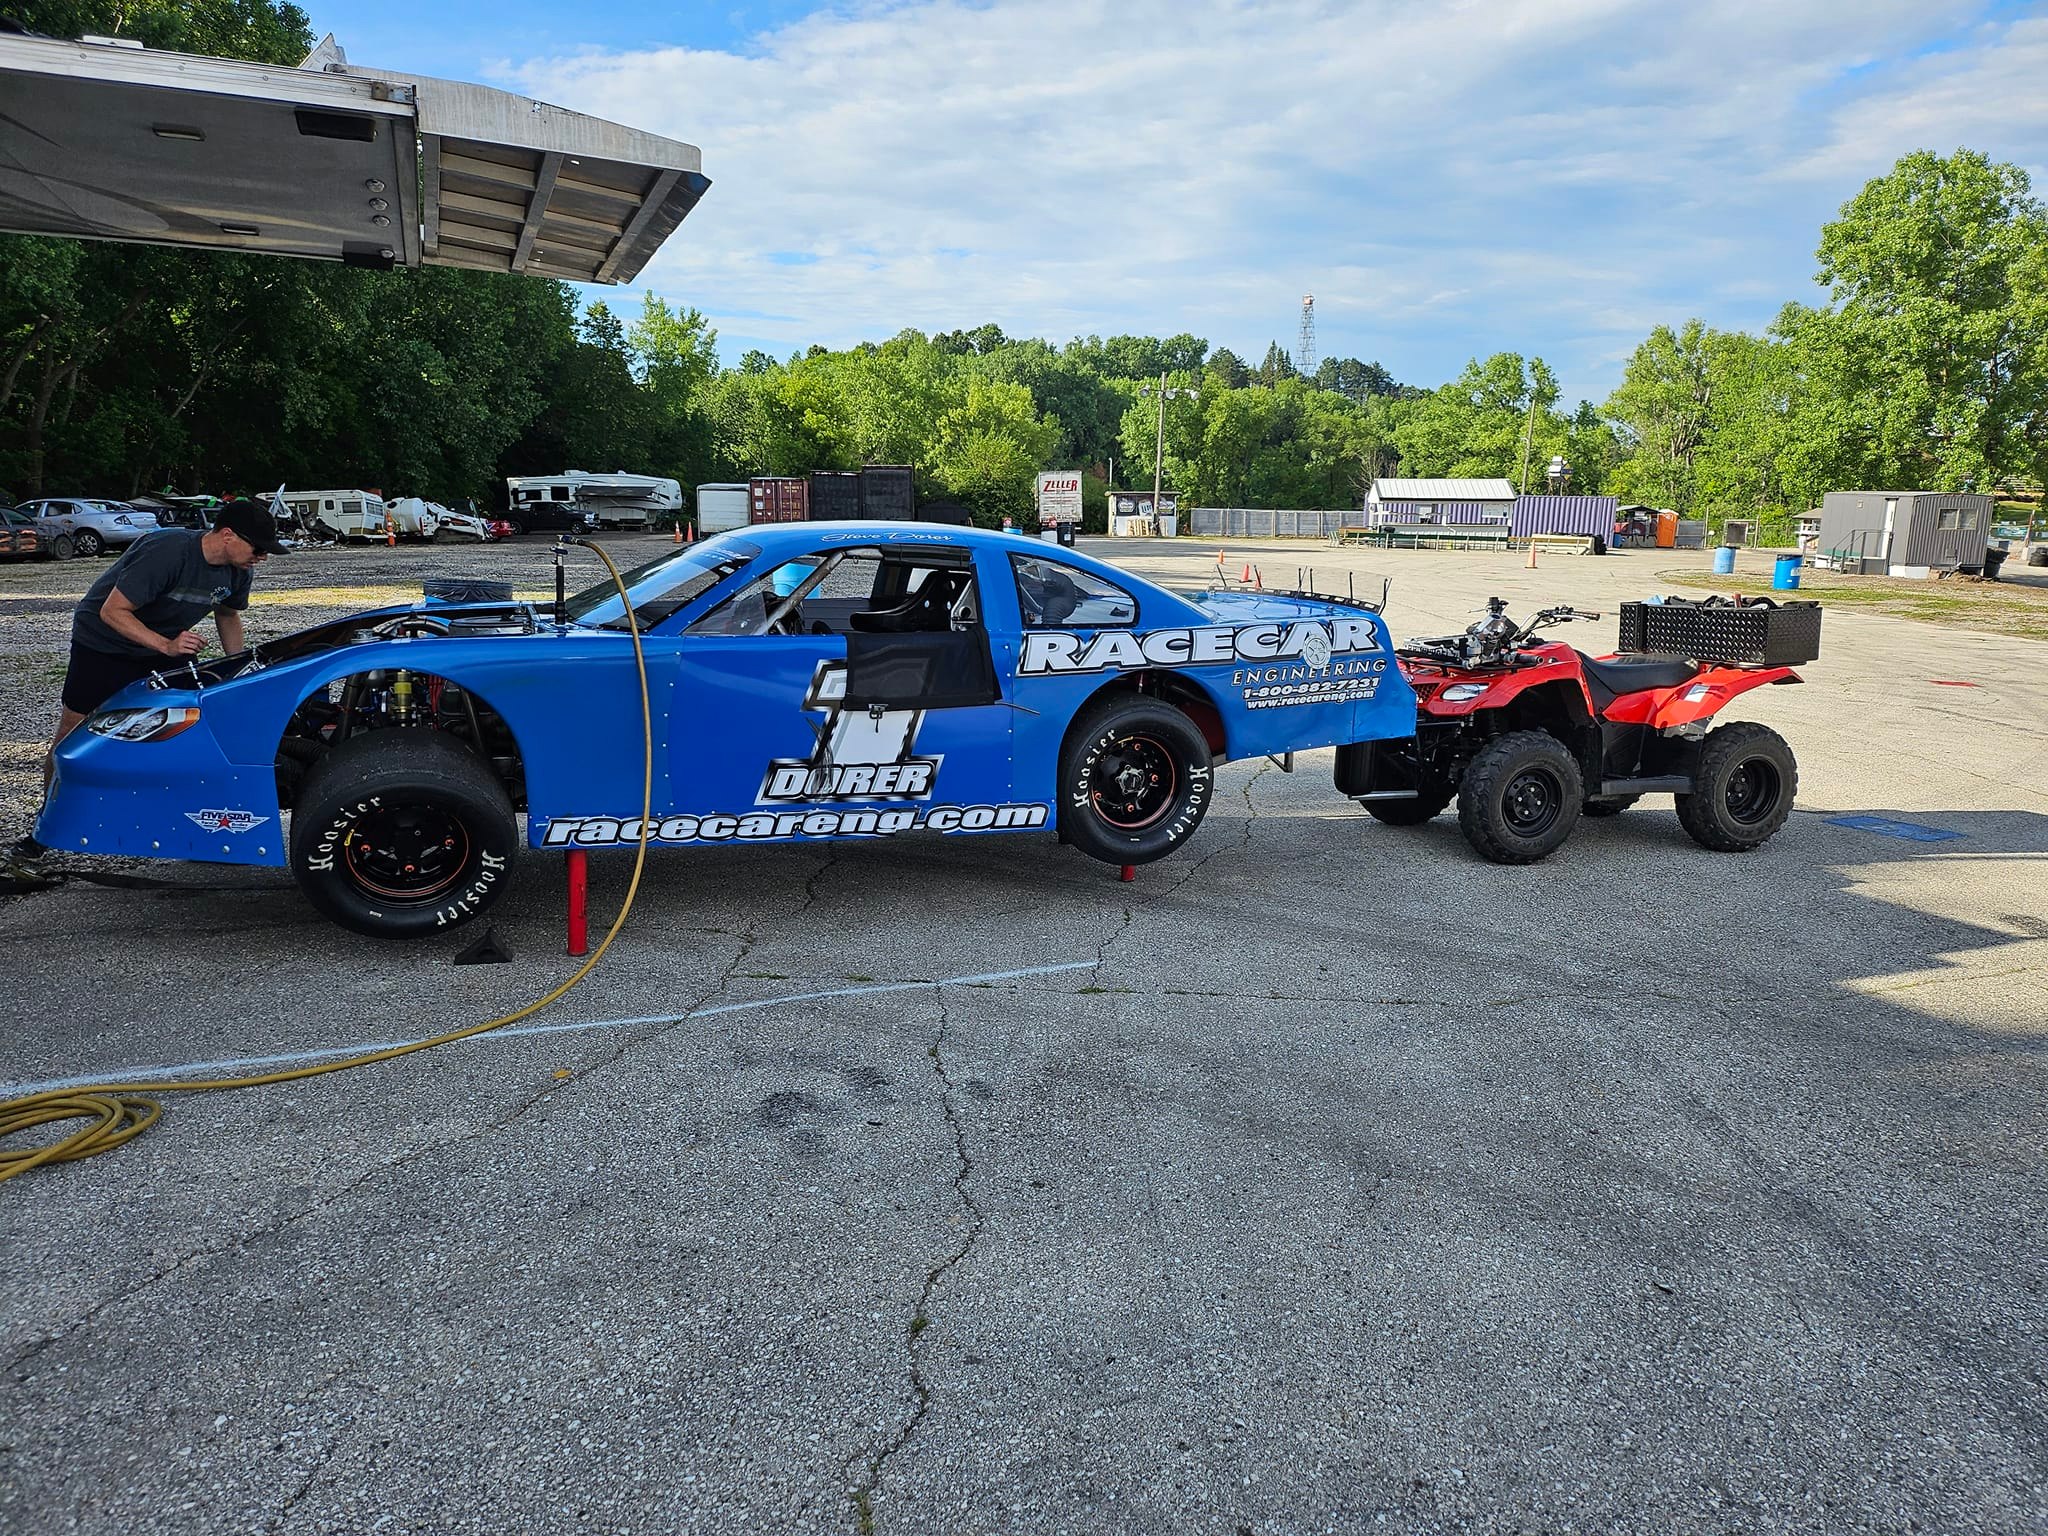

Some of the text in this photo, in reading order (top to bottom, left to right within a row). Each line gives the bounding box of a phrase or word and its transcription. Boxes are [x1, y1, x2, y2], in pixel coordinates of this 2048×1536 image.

[1021, 620, 1381, 675] RACECAR
[1232, 659, 1387, 686] ENGINEERING
[1243, 677, 1380, 699] 1-800-882-7231
[1247, 689, 1375, 709] www.racecareng.com
[767, 764, 932, 796] DORER
[1073, 729, 1116, 808] Hoosier
[202, 811, 252, 822] FIVE STAR
[1166, 764, 1209, 841] Hoosier
[308, 796, 381, 872] Hoosier
[544, 803, 1049, 846] racecareng.com
[437, 849, 506, 926] Hoosier
